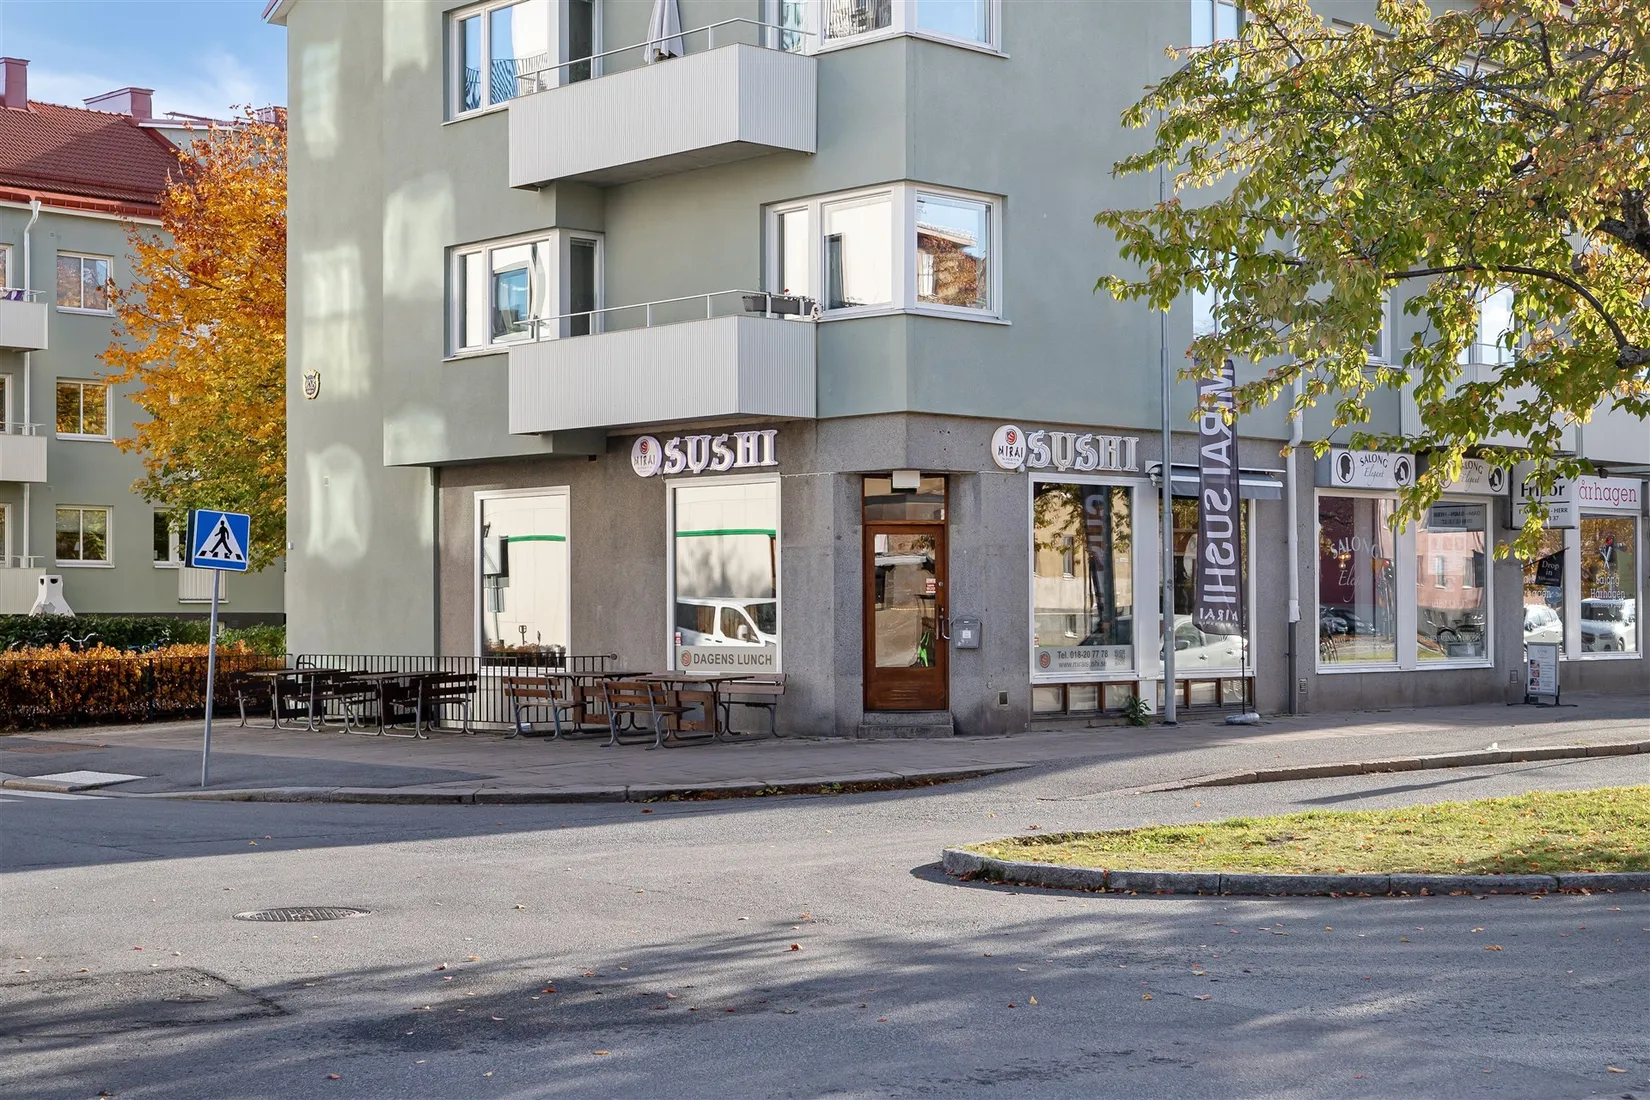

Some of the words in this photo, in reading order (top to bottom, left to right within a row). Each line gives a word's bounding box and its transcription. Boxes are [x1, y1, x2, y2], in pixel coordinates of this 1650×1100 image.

[663, 430, 779, 474] SUSHI
[997, 445, 1024, 459] MIRAI
[1027, 430, 1140, 472] SUSHI
[634, 454, 656, 467] MIRAI
[1360, 453, 1389, 469] SALONG
[1579, 479, 1637, 507] århagen
[1330, 535, 1380, 560] SALONG
[1541, 560, 1560, 571] Drop
[1545, 568, 1553, 576] in
[693, 653, 735, 665] DAGENS
[737, 654, 772, 666] LUNCH
[1057, 650, 1068, 660] Tel.
[1069, 650, 1091, 659] 018-20
[1092, 649, 1100, 659] 77
[1101, 649, 1109, 658] 78
